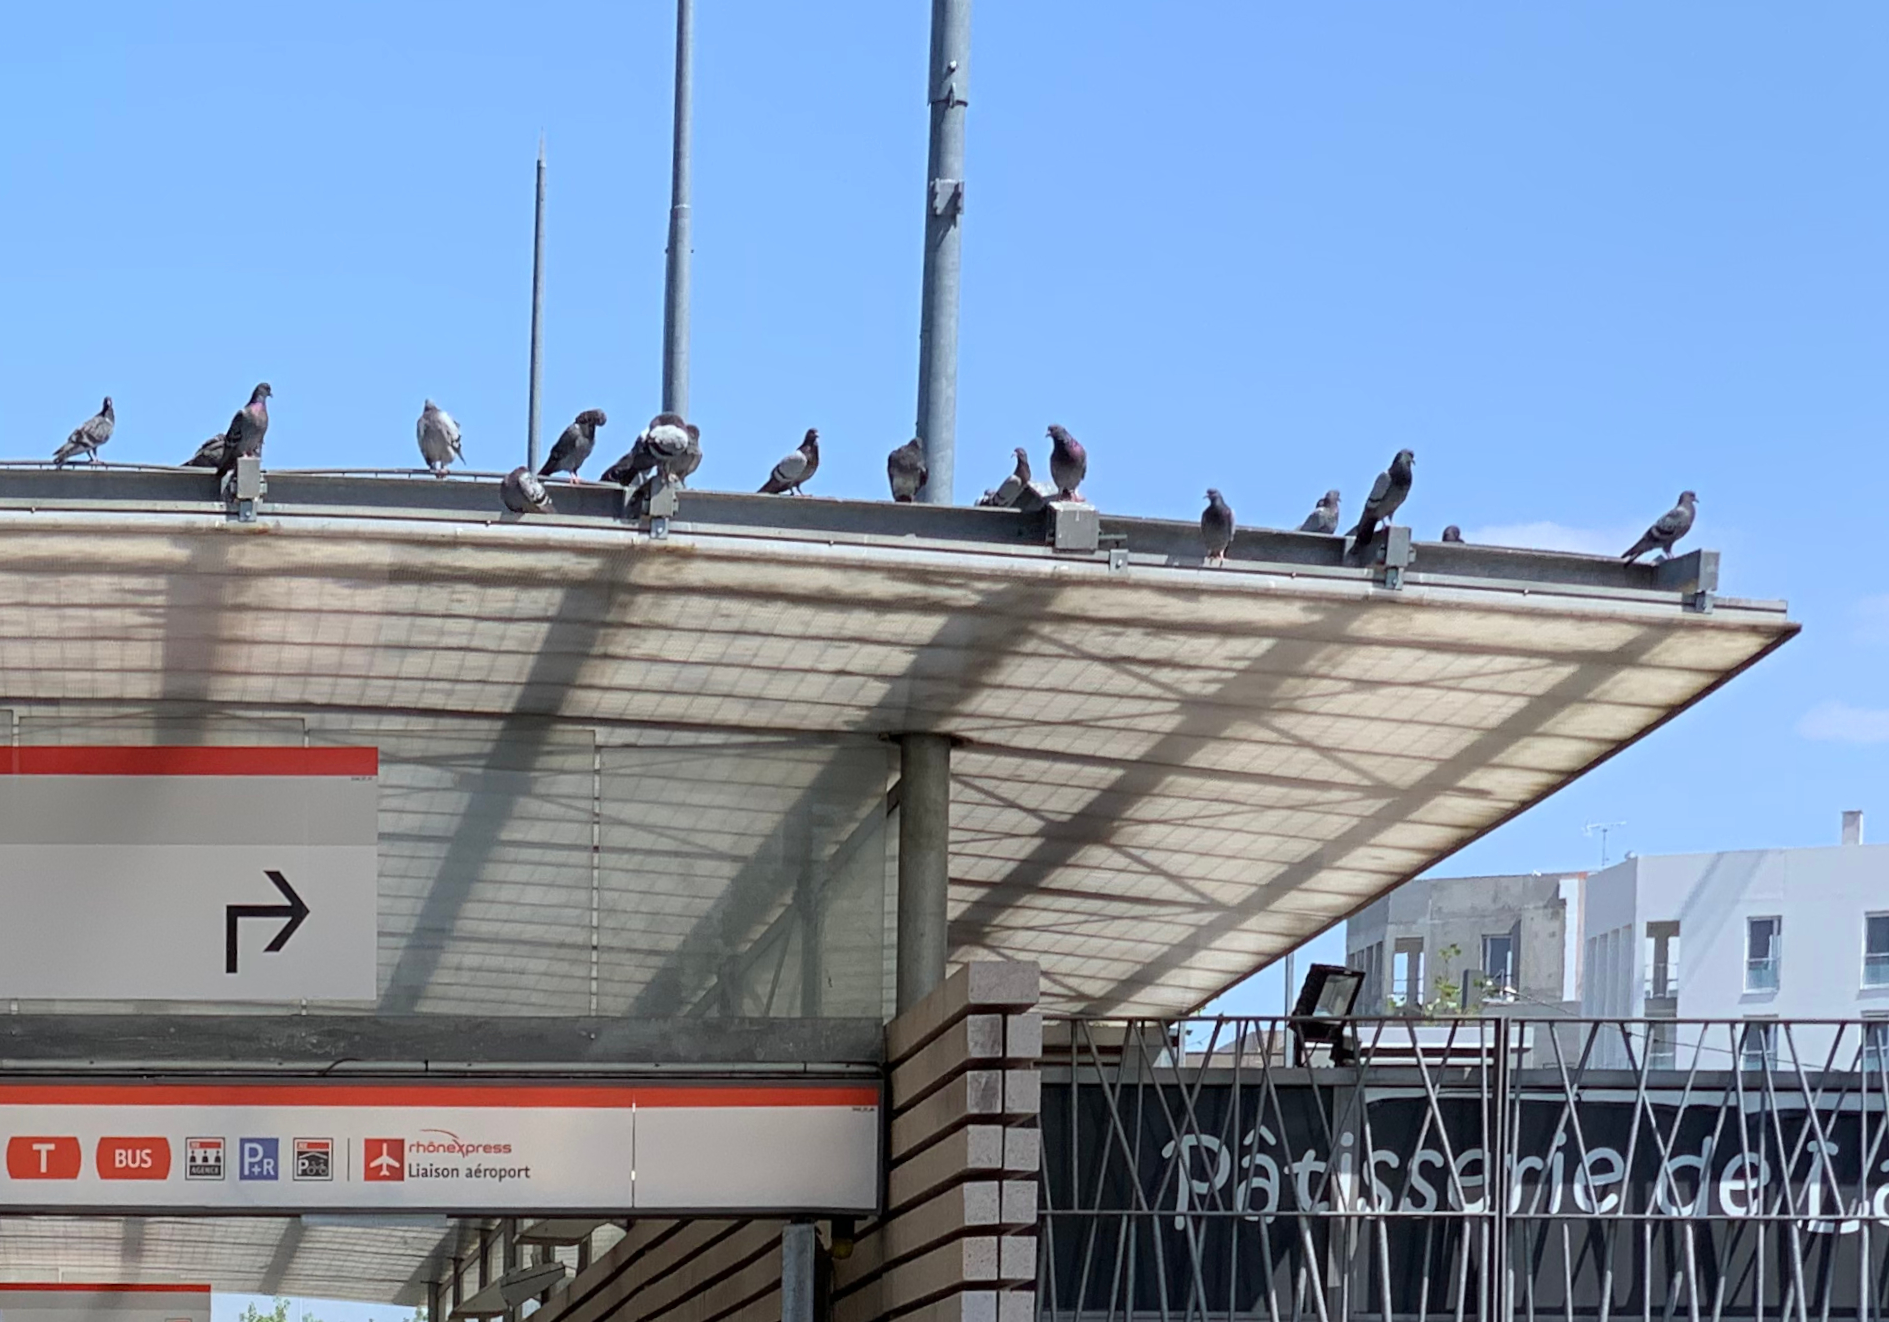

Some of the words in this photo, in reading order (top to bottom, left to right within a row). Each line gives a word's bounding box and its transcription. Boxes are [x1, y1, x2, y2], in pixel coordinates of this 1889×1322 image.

[31, 1142, 55, 1173] T
[114, 1147, 153, 1169] BUS
[408, 1139, 512, 1158] rhônexpress
[408, 1162, 459, 1178] Liaison
[464, 1162, 531, 1183] aéroport
[1161, 1125, 1625, 1231] Pâtisserie
[1656, 1136, 1772, 1219] de
